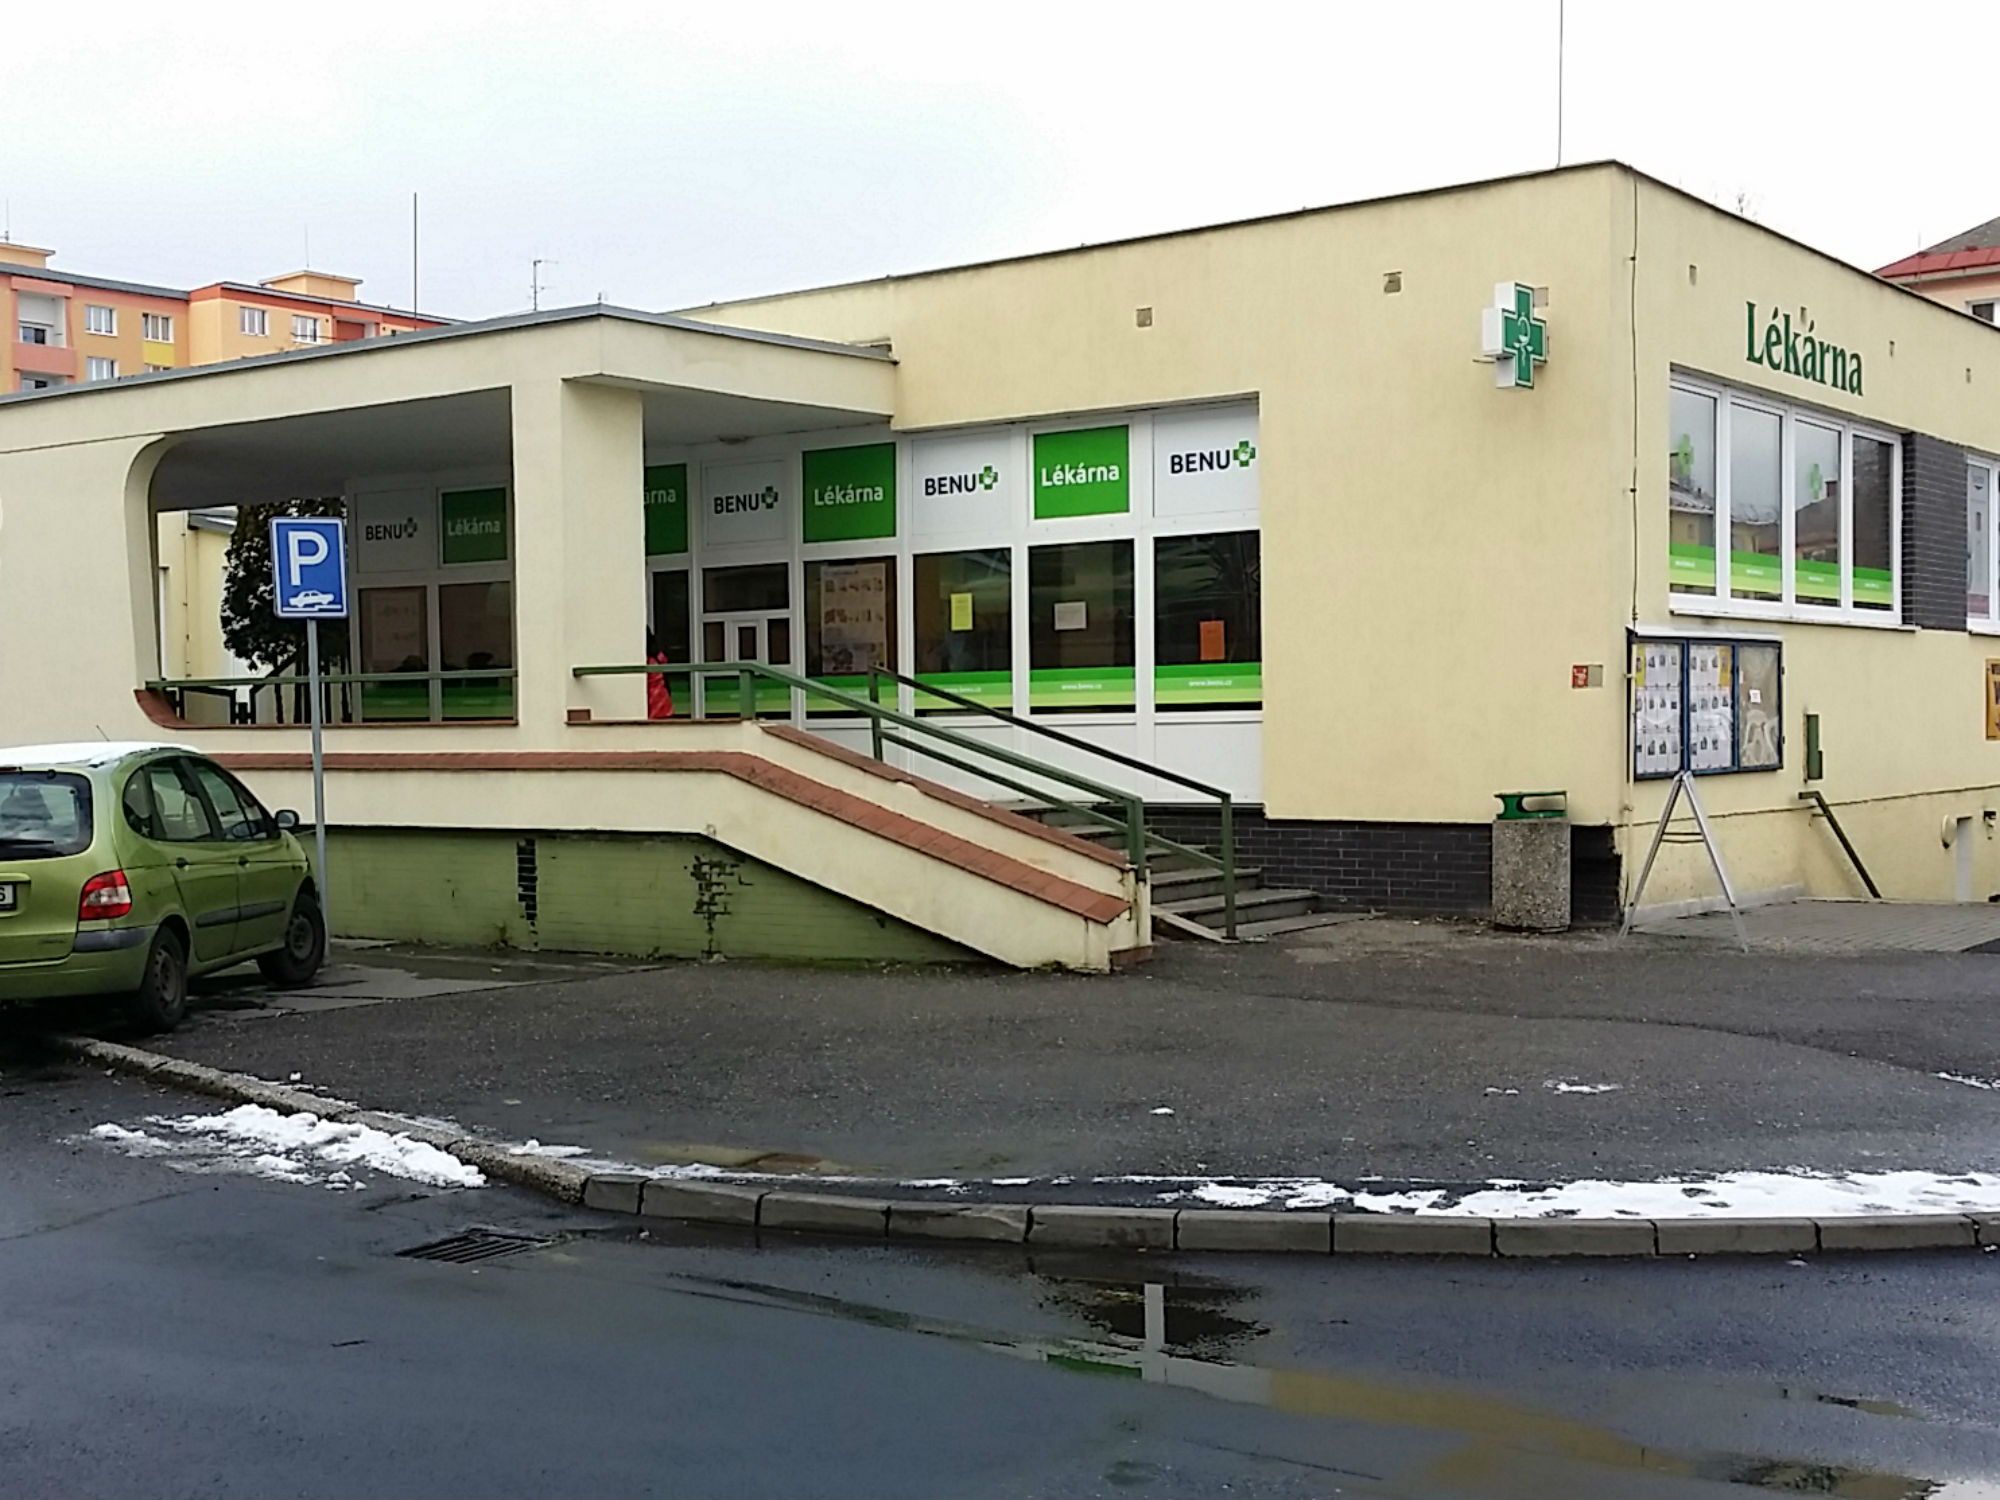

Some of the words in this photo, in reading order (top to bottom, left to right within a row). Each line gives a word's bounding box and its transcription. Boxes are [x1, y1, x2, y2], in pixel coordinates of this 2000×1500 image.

[1746, 301, 1863, 396] Lékárna
[1170, 450, 1231, 474] BENU
[924, 474, 977, 496] BENU
[1041, 462, 1120, 488] Lékárna
[714, 493, 760, 514] BENU
[813, 482, 884, 507] Lékárna
[365, 524, 403, 541] BENU
[448, 517, 501, 536] Lékárna
[287, 530, 329, 586] P
